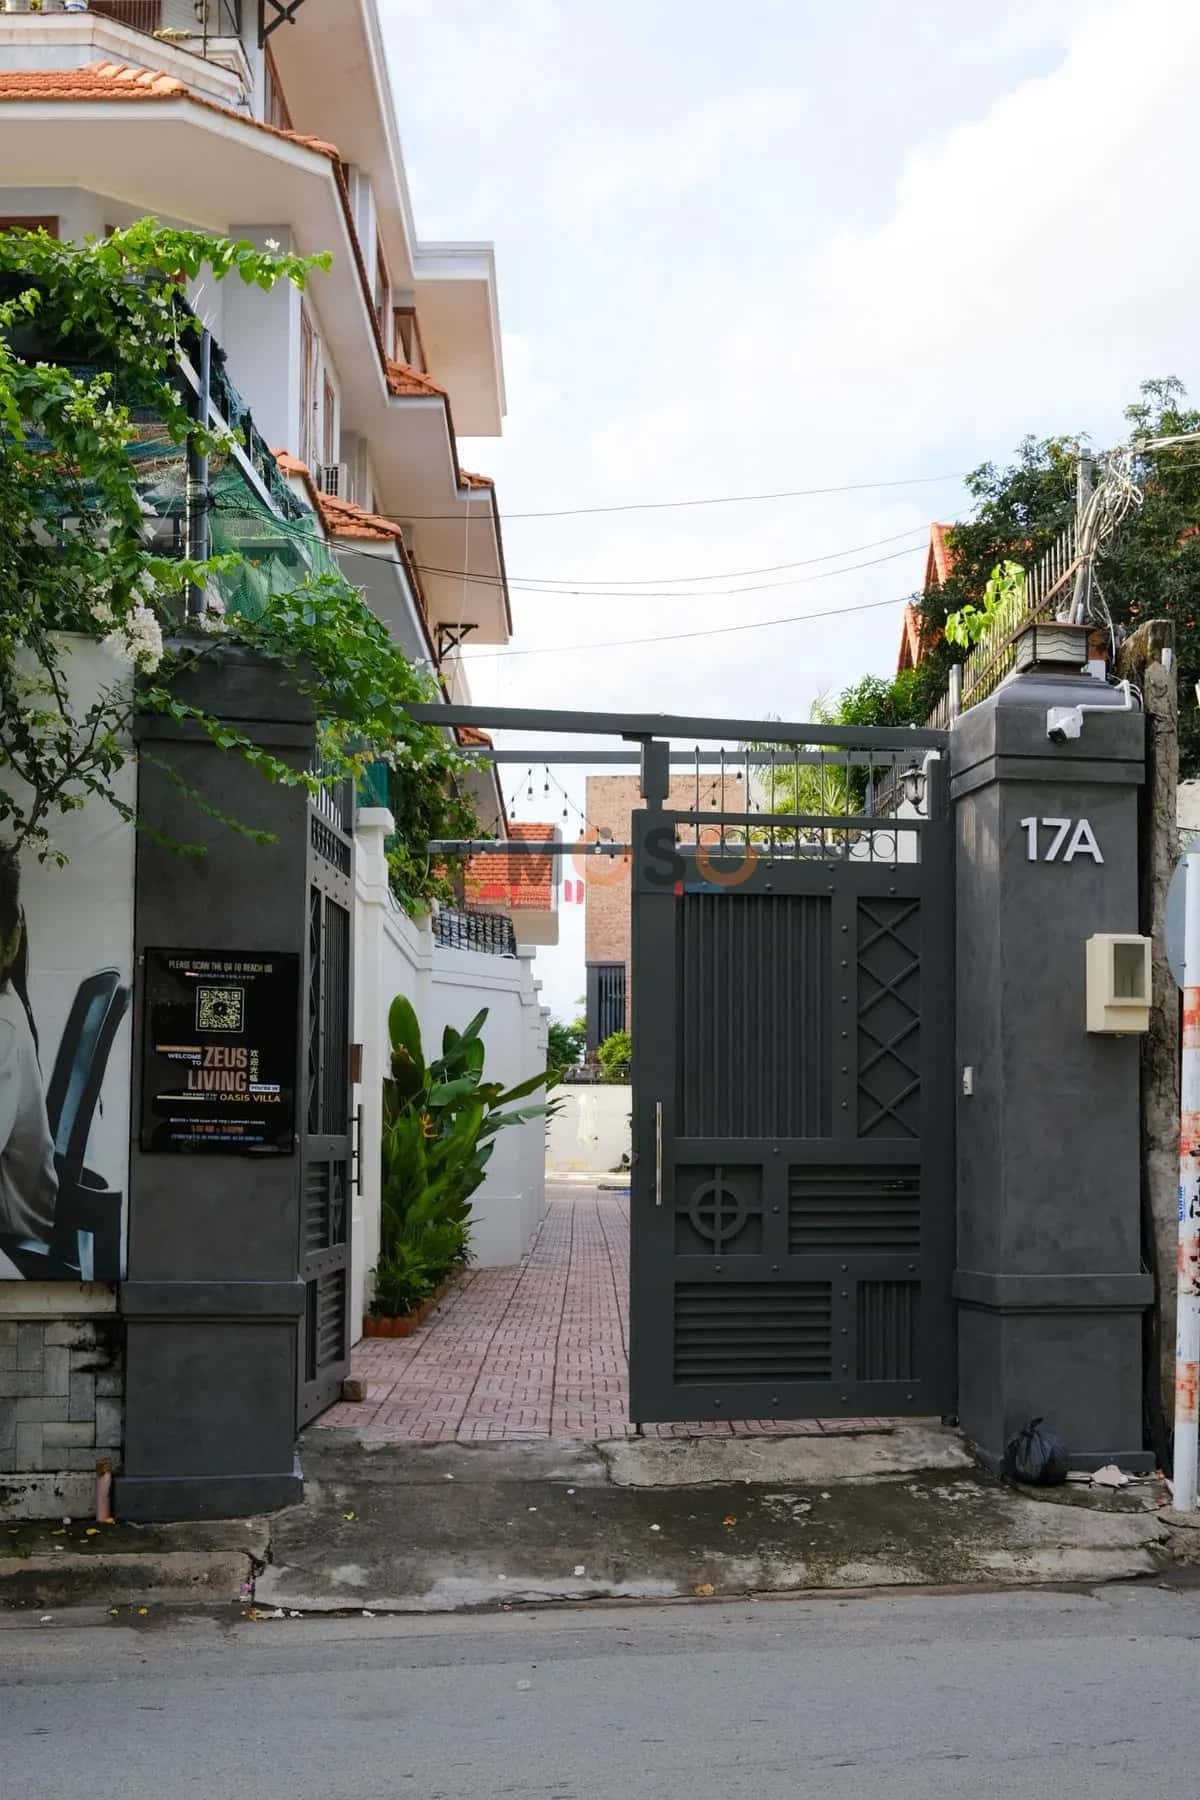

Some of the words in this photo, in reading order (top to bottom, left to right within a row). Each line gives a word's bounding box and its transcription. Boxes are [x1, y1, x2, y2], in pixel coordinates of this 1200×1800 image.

[1020, 816, 1105, 863] 17A
[203, 1046, 248, 1069] ZEUS
[187, 1069, 247, 1092] LIVING
[220, 1093, 251, 1102] OASIS
[253, 1094, 281, 1103] VILLA
